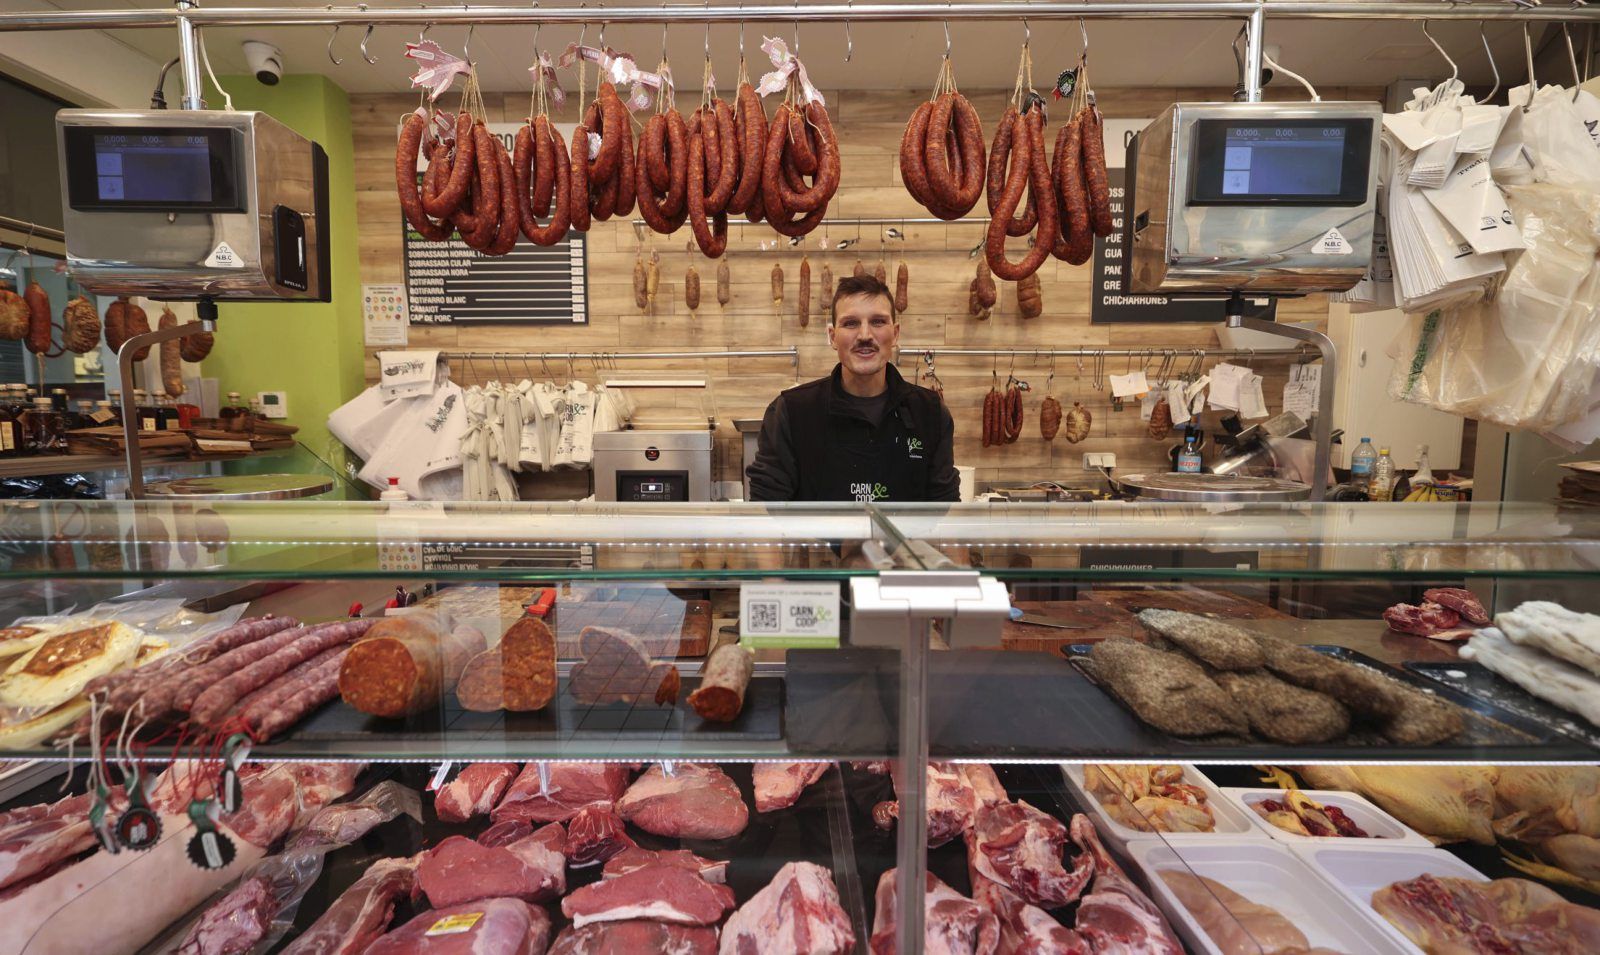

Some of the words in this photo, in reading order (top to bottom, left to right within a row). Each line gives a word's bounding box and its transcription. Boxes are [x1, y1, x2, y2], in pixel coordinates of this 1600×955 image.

[850, 483, 871, 494] CARN
[790, 606, 814, 617] CARN
[795, 617, 818, 627] COOP
